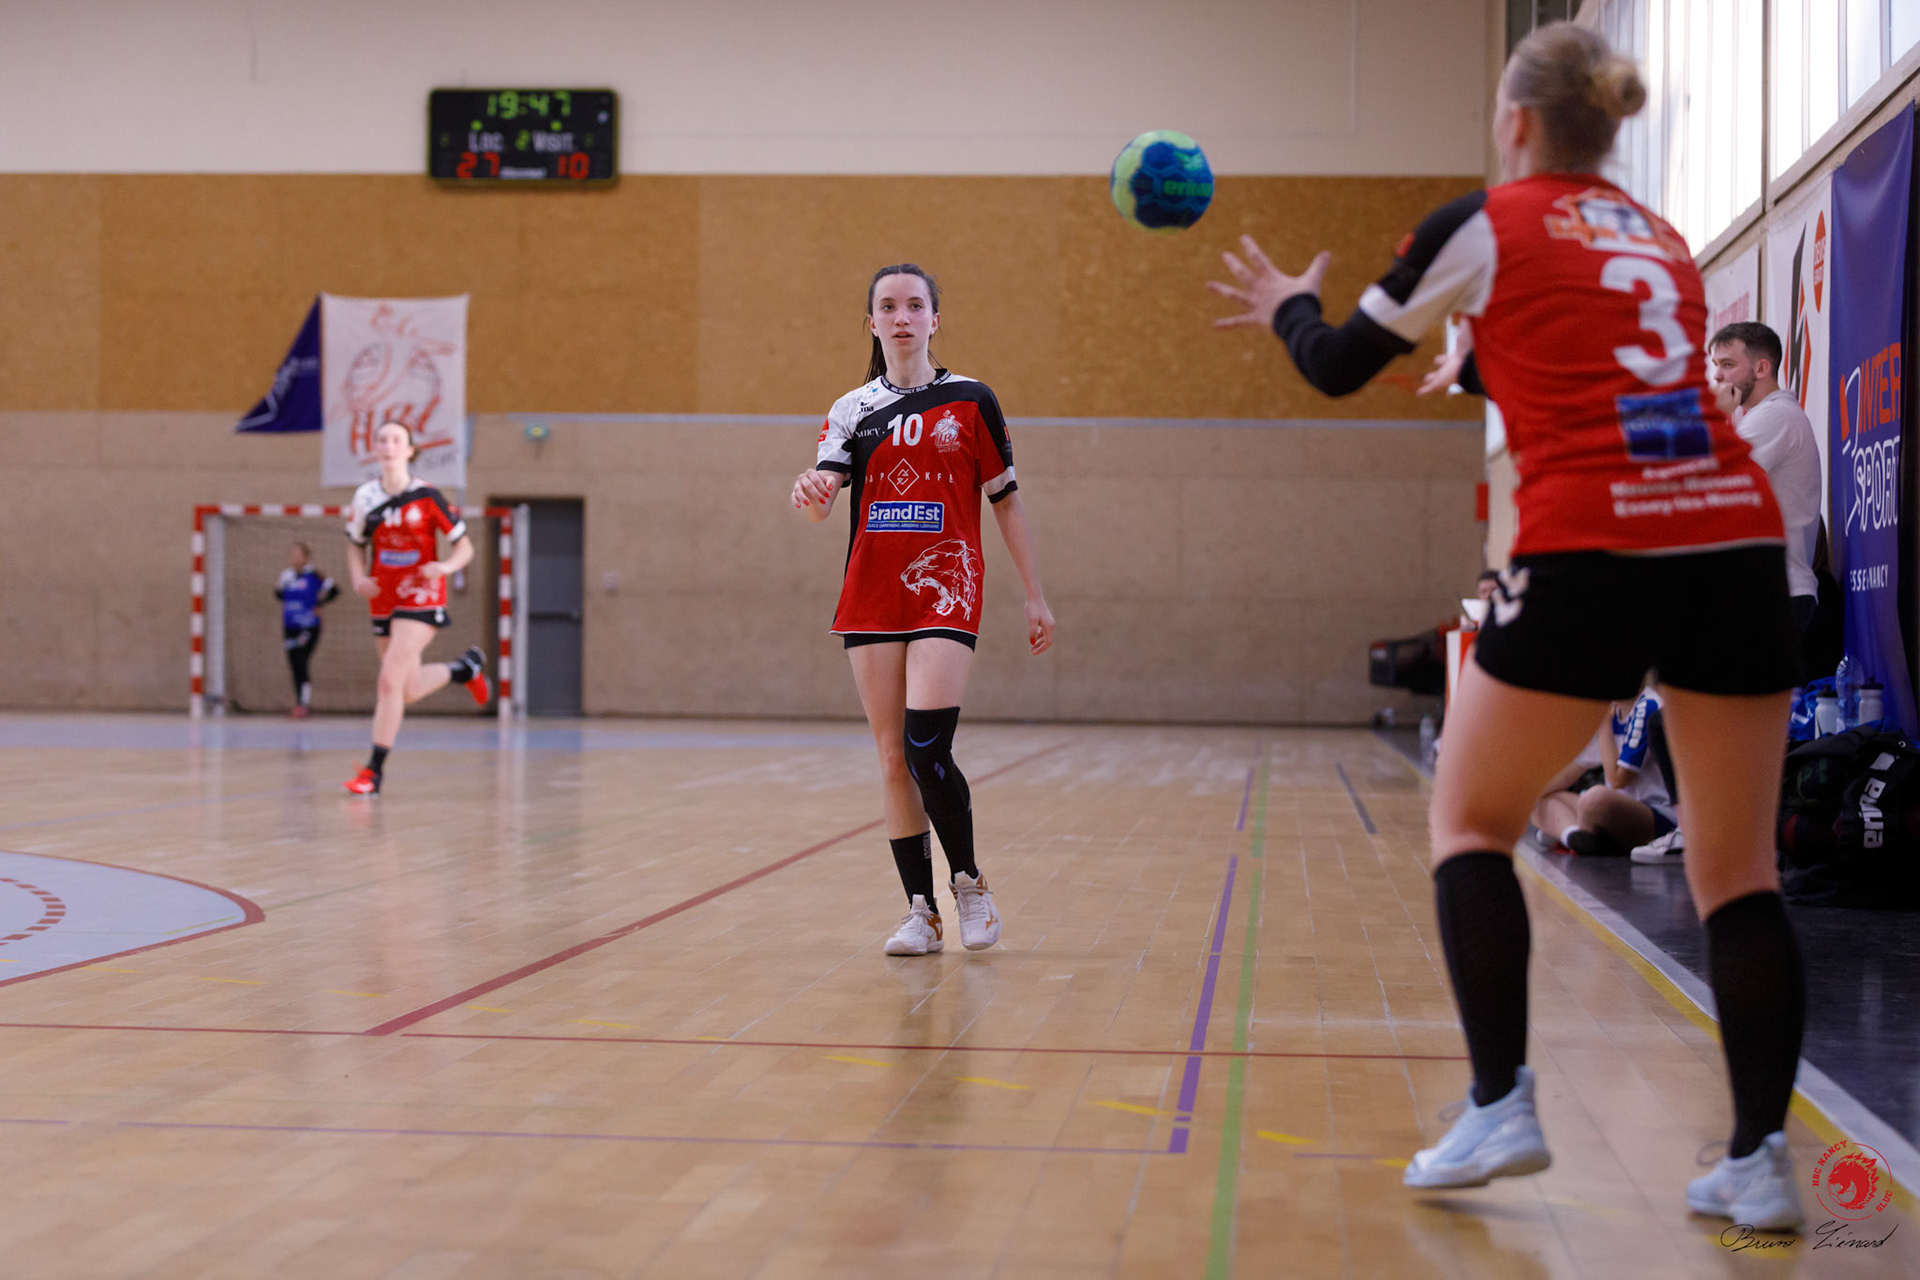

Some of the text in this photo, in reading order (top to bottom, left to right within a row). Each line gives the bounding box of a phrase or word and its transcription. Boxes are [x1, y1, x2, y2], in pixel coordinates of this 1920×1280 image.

[487, 90, 571, 119] 19:47
[515, 129, 531, 151] 2
[456, 152, 500, 179] 27
[558, 152, 590, 179] 10
[1601, 255, 1694, 386] 3
[1858, 342, 1900, 434] INTER
[887, 413, 924, 447] 10
